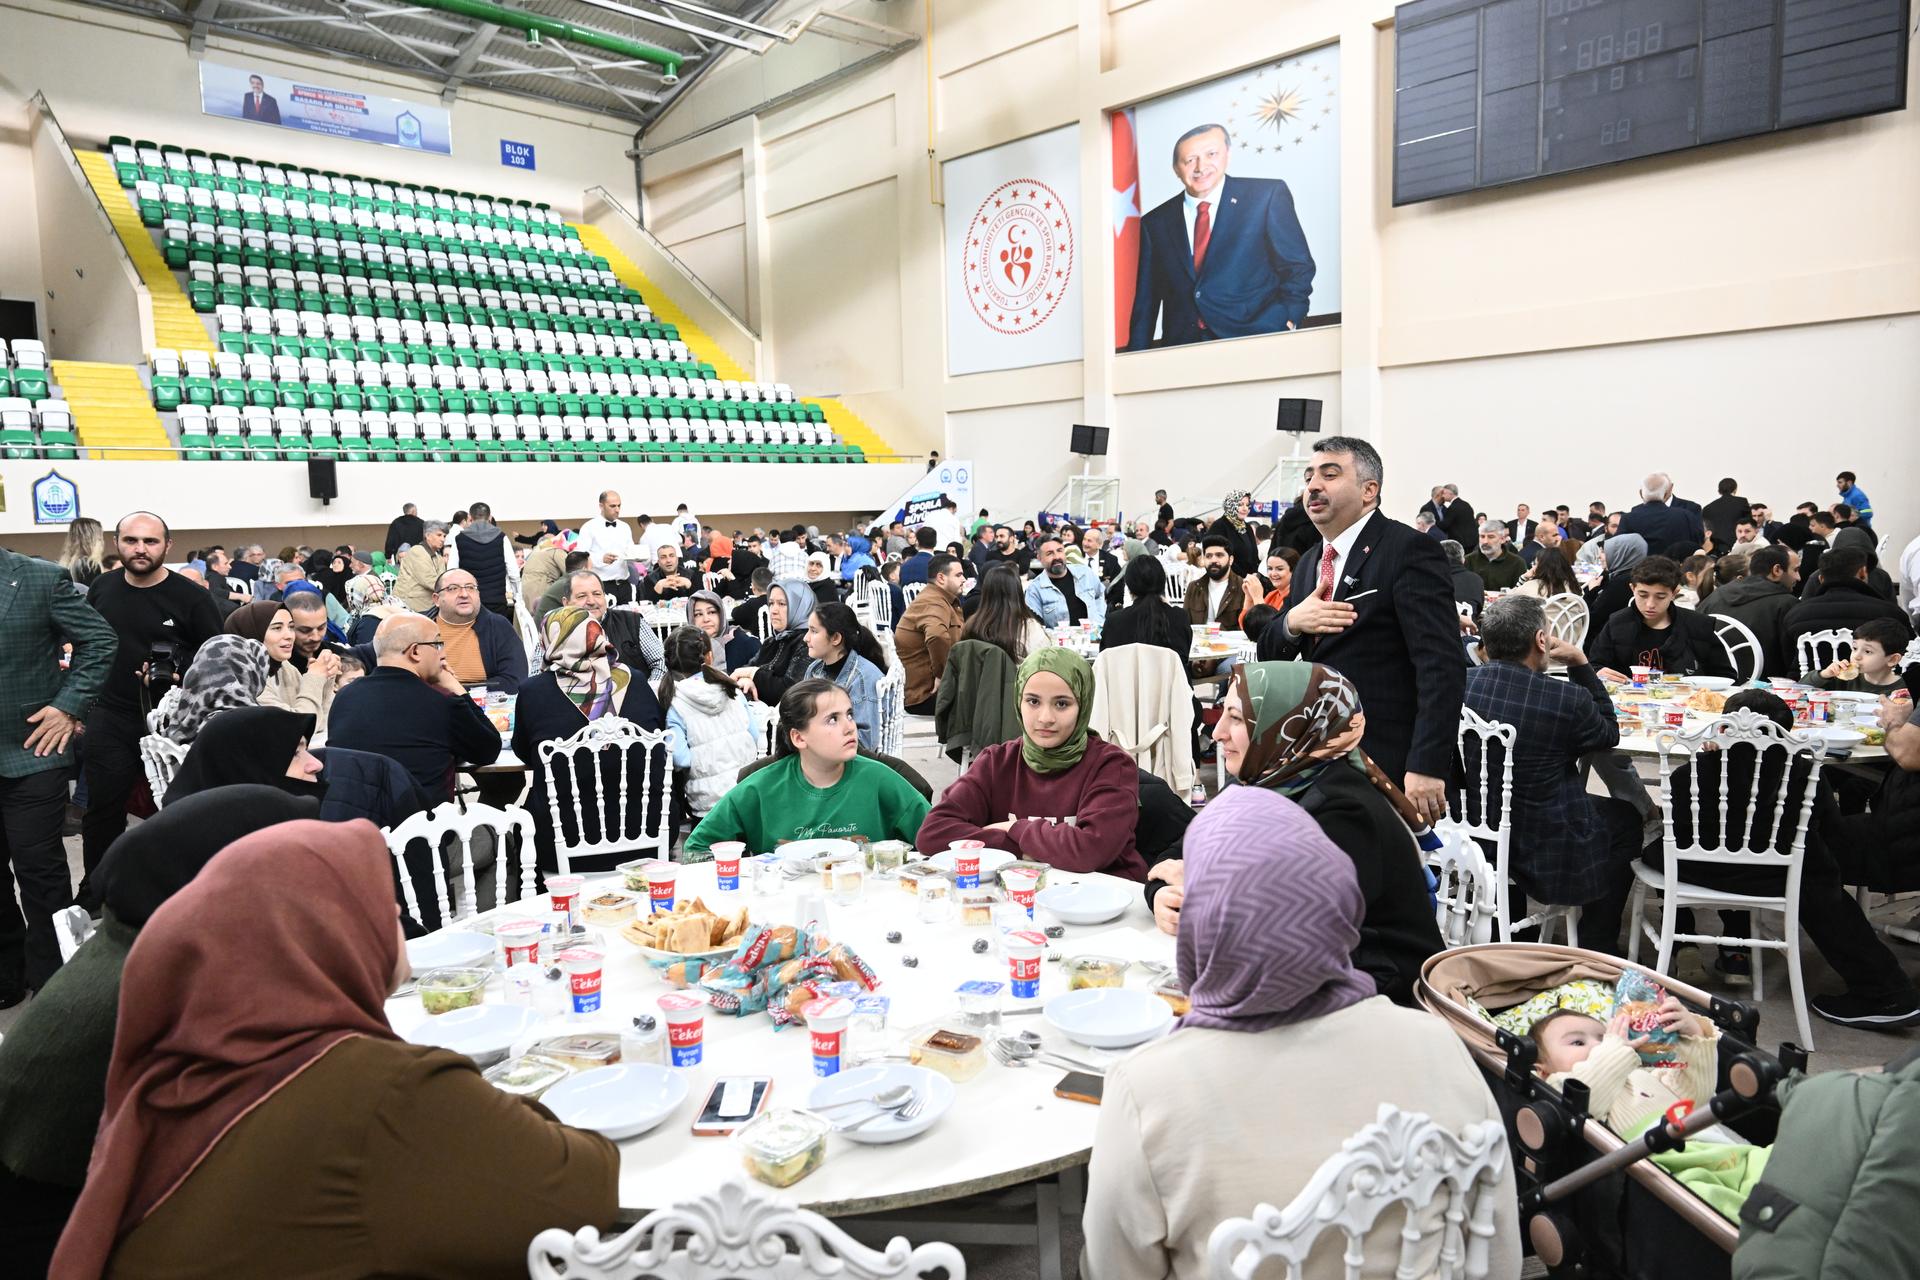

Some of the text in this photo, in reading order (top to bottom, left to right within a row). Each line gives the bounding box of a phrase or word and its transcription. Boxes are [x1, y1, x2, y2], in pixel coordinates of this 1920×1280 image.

[505, 143, 530, 157] BLOK
[511, 155, 525, 166] 103
[1005, 207, 1035, 219] GENÇLİK
[1036, 214, 1044, 227] VE
[1042, 226, 1052, 252] SPOR
[909, 498, 942, 514] SPORLA
[903, 510, 927, 526] BÜYÜ
[794, 826, 816, 840] My
